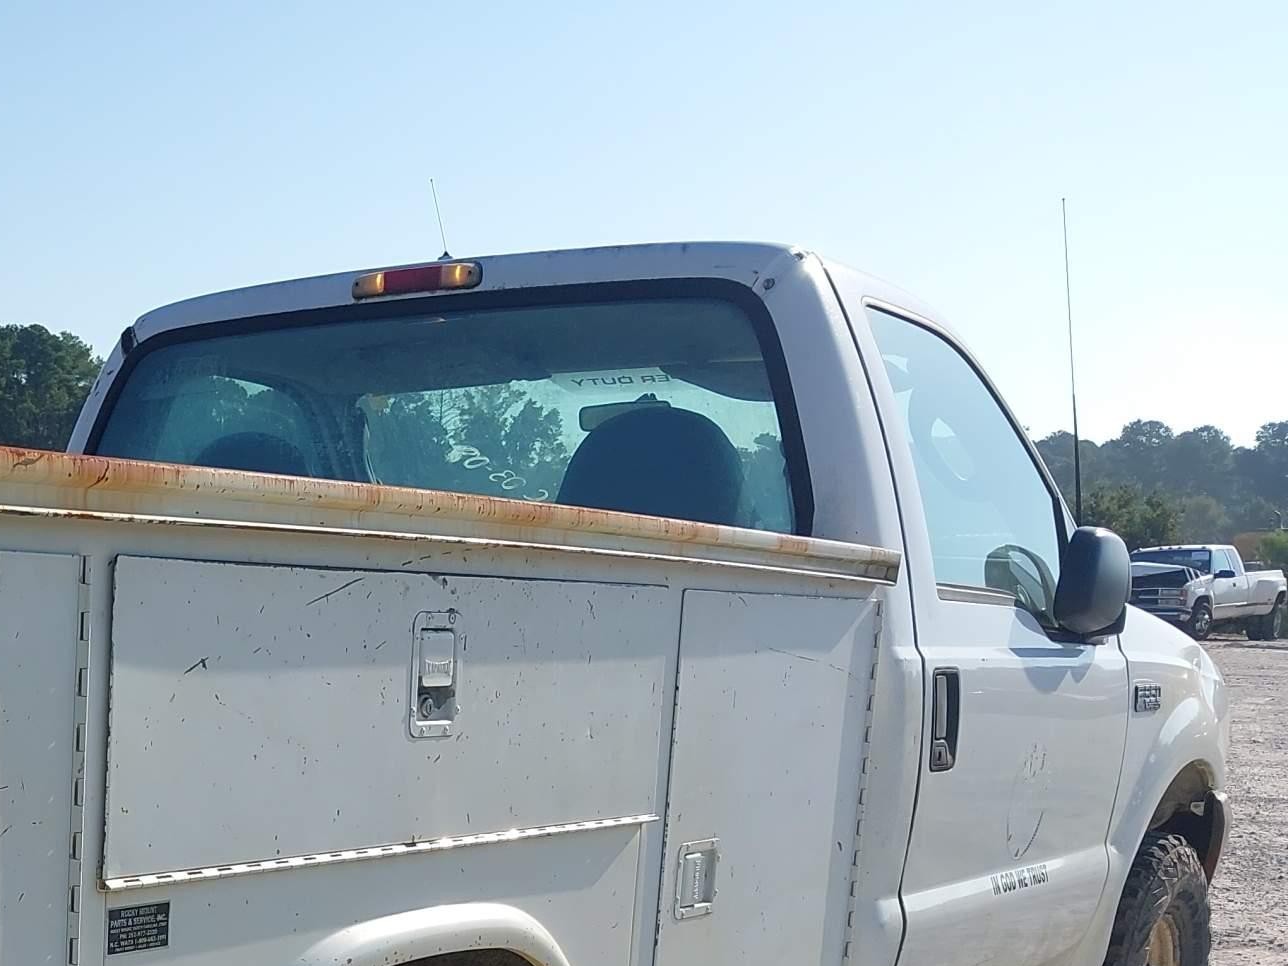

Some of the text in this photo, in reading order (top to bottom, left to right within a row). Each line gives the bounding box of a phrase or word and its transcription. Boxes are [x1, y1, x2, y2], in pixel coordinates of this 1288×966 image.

[990, 864, 1049, 896] IN GOD WE TRUST
[110, 919, 127, 928] PARTS
